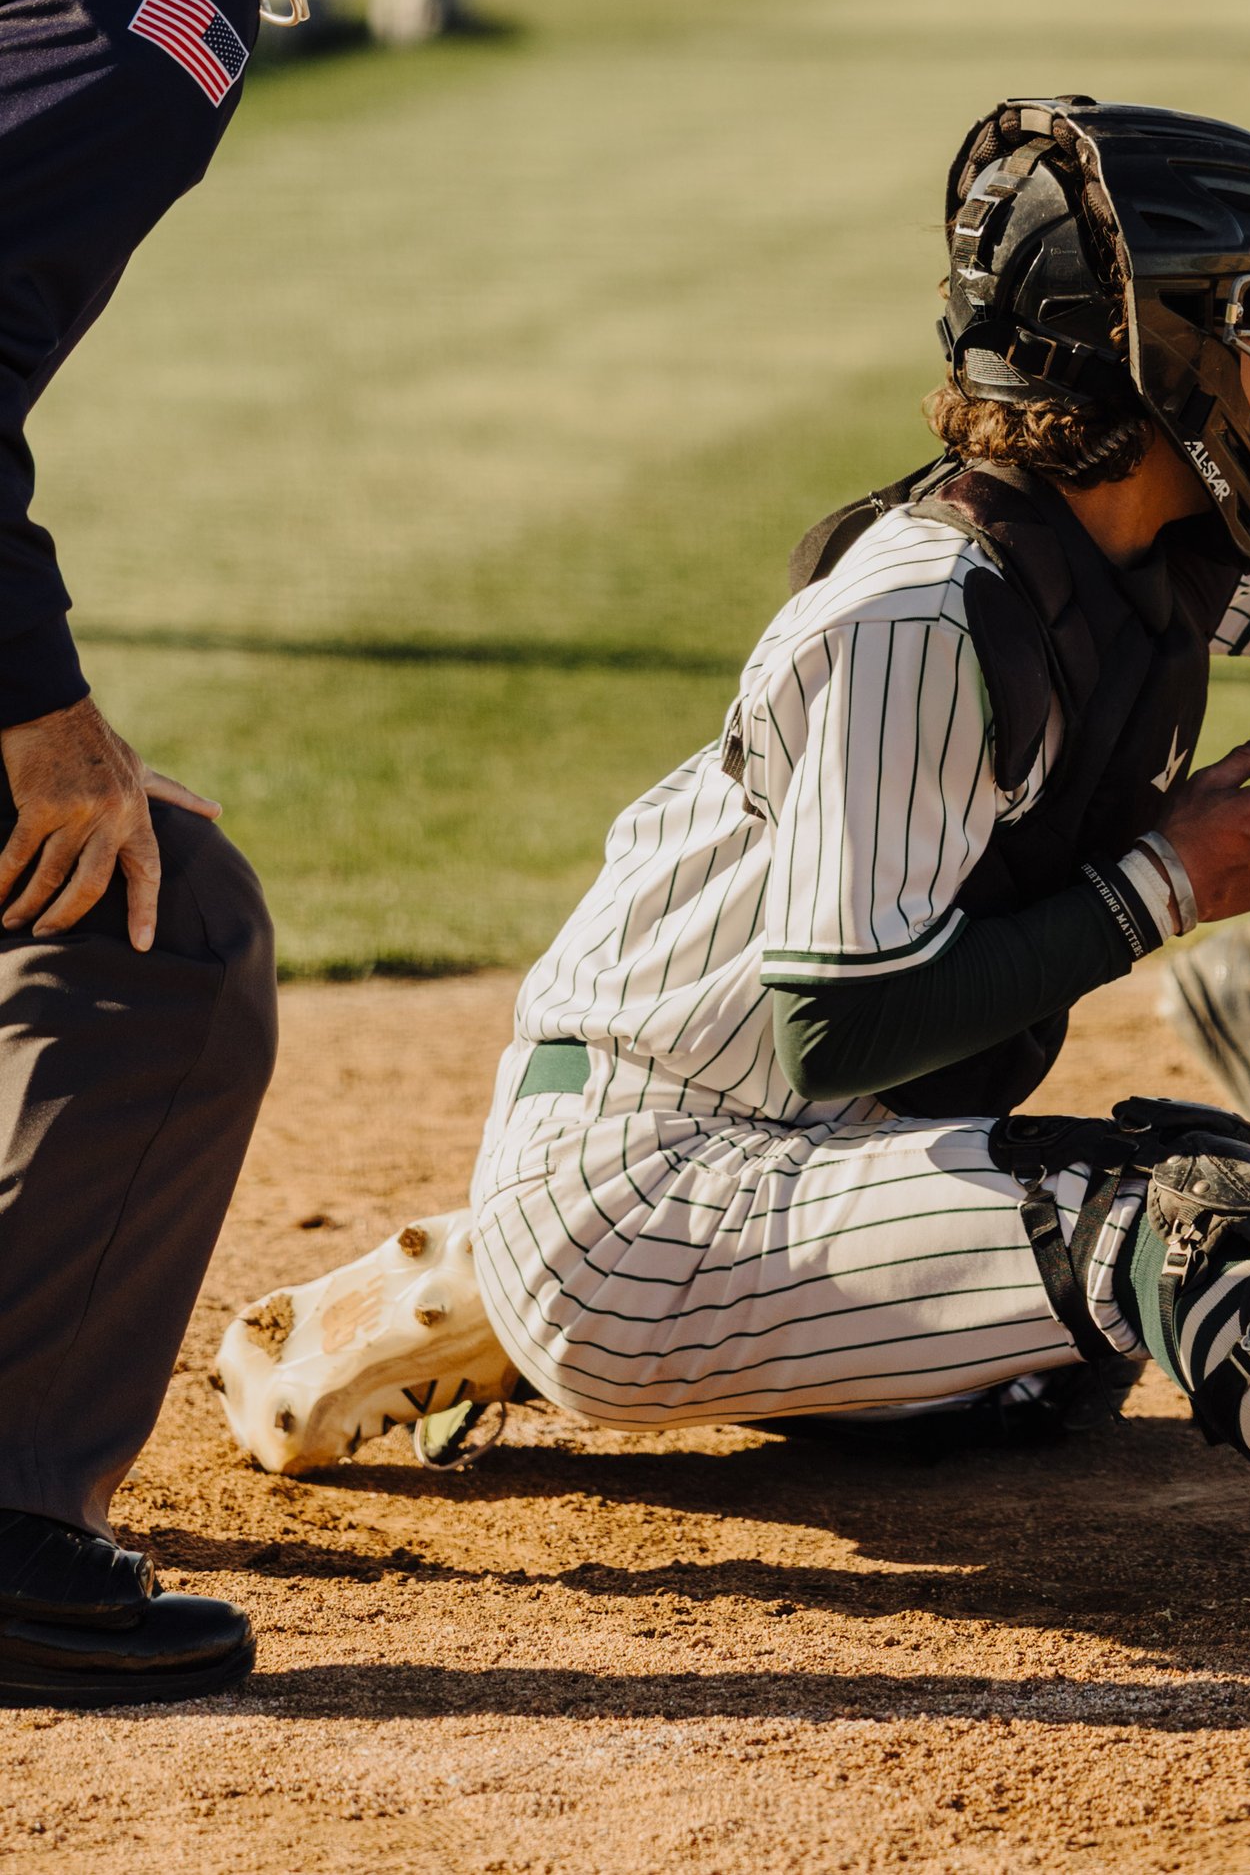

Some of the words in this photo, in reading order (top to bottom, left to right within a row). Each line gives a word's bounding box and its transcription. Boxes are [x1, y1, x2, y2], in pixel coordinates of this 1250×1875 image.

[1183, 441, 1231, 503] ALL-STAR
[1080, 863, 1121, 913] EVERYTHING
[1116, 912, 1145, 957] MATTERS
